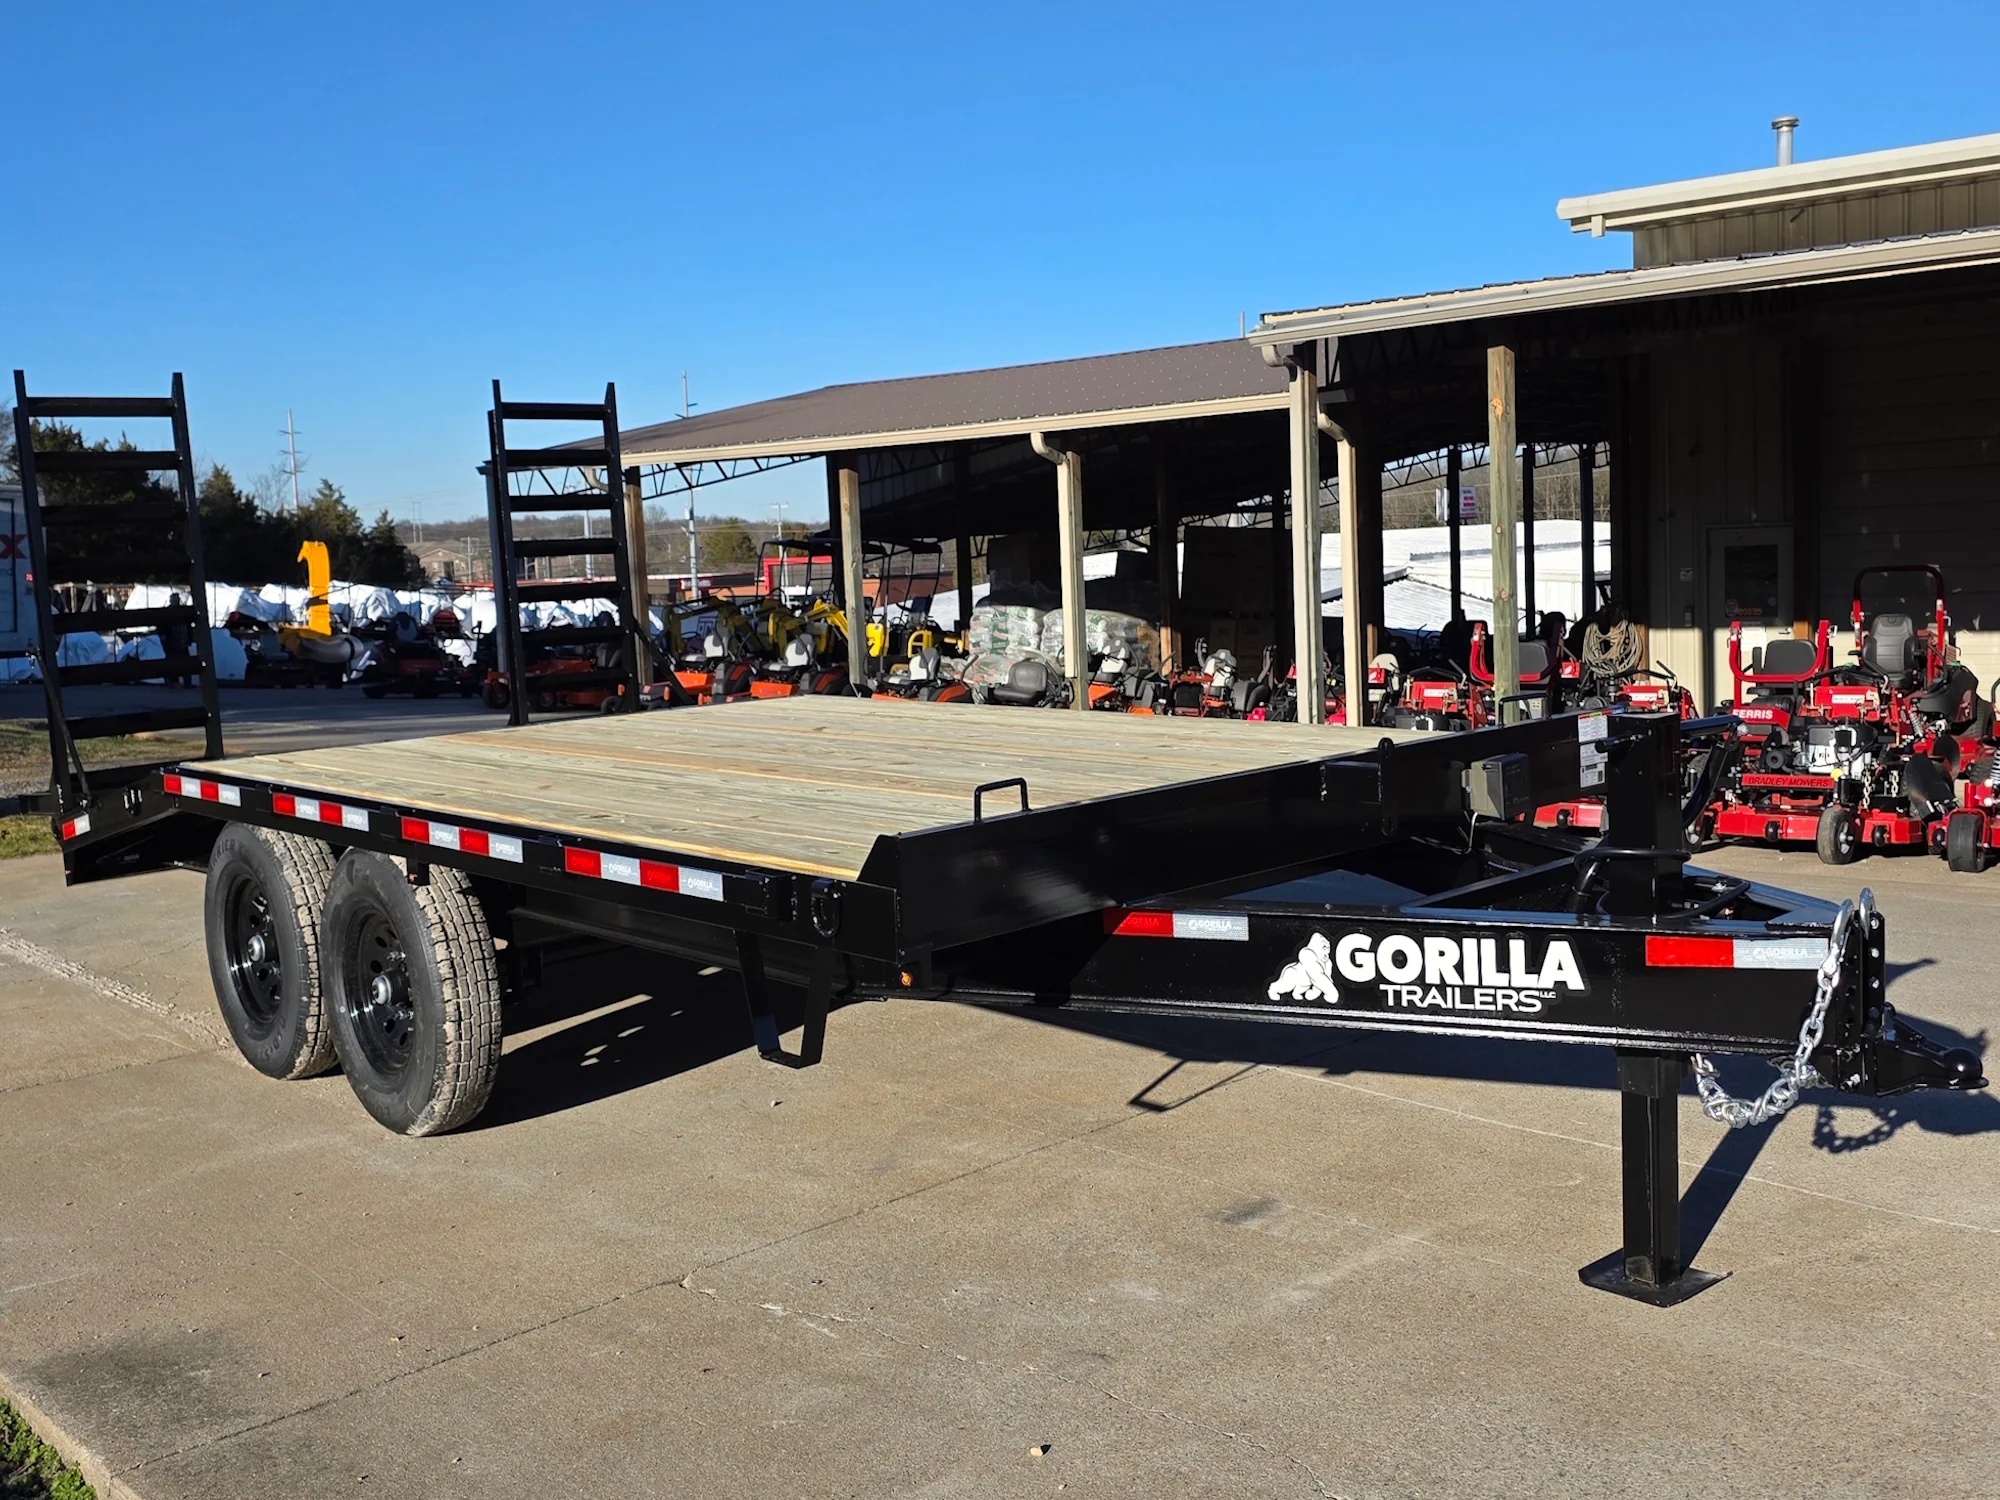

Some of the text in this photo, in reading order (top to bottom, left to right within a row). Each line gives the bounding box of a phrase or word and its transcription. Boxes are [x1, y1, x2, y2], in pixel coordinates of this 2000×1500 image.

[1732, 708, 1773, 720] FERRIS
[1748, 776, 1829, 787] BRADLEY MOWERS
[1198, 920, 1232, 929] GORILLA
[1765, 948, 1808, 957] GORILLA
[1336, 933, 1585, 991] GORILLA
[1379, 984, 1556, 1013] TRAILERS LLC
